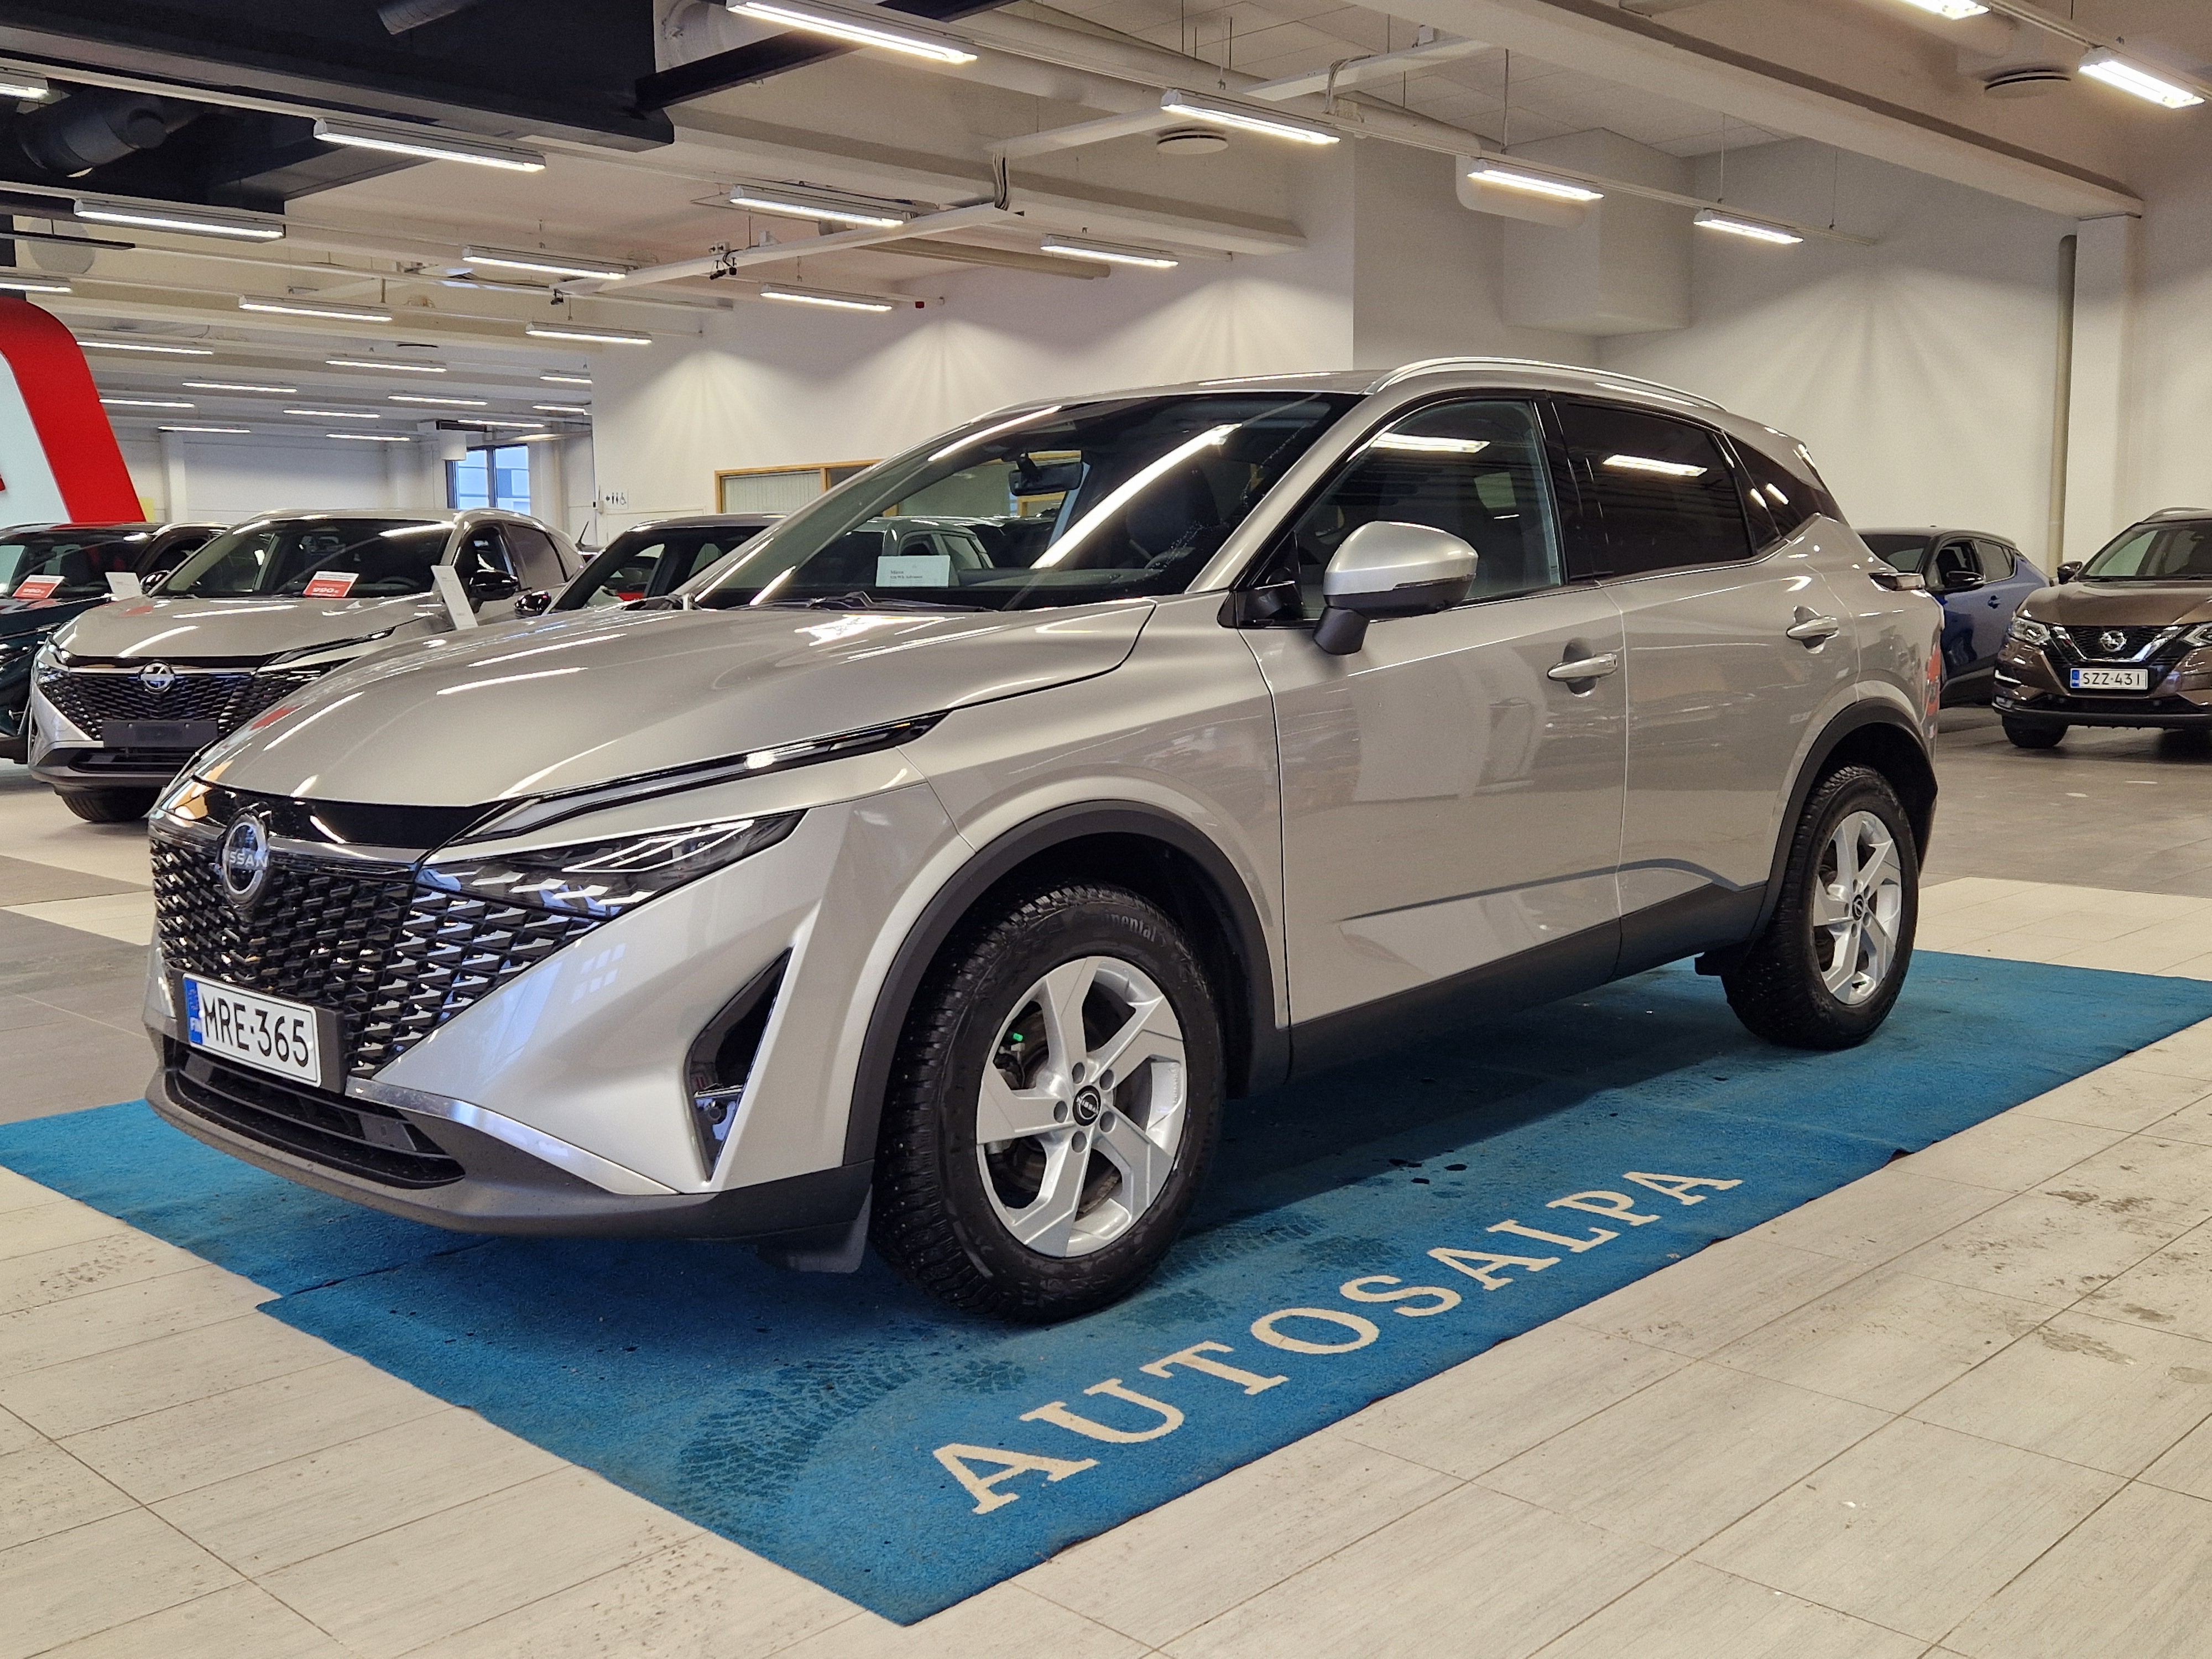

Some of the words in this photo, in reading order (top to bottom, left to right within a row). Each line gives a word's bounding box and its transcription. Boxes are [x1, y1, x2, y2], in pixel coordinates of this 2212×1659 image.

[2083, 672, 2140, 685] SZZ-431
[223, 849, 268, 869] SSAN
[201, 993, 309, 1068] MRE-365
[932, 1170, 1744, 1514] AUTOSALPA
